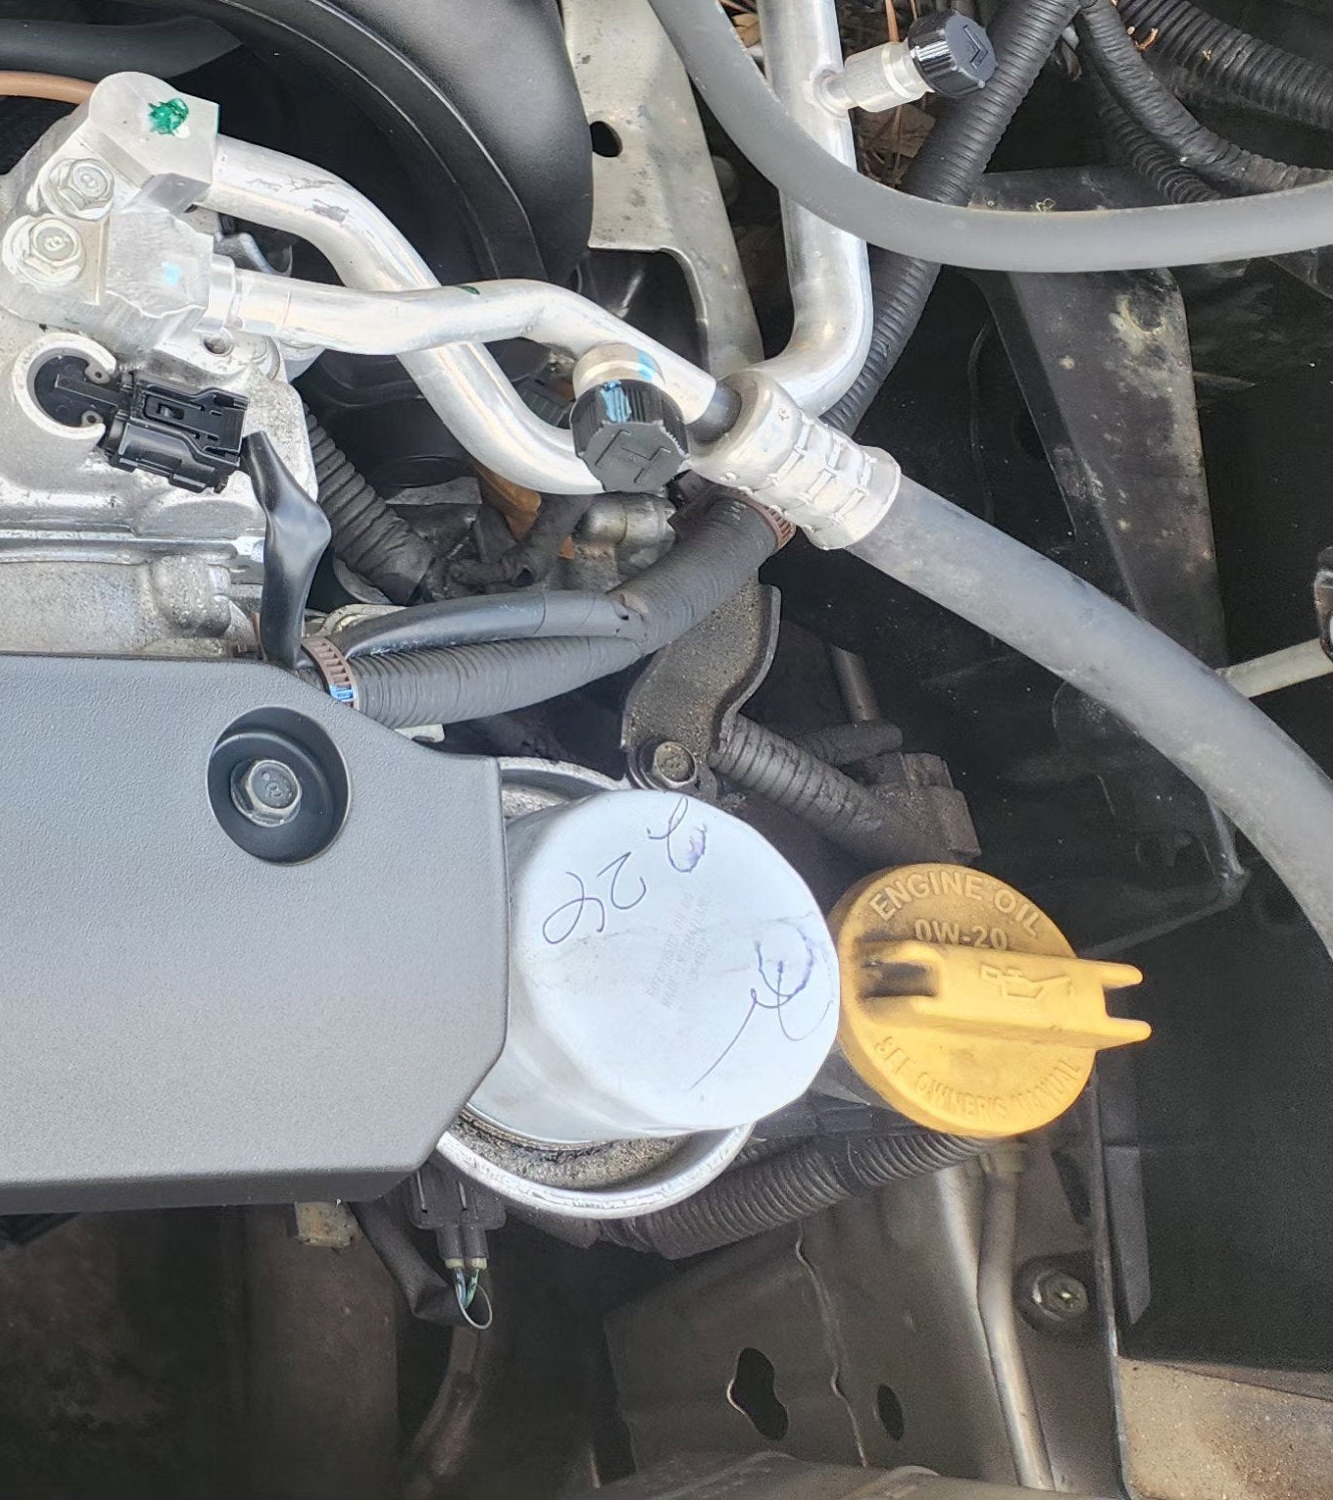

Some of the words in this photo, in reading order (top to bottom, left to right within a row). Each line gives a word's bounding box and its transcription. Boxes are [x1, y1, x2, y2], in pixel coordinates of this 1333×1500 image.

[869, 871, 984, 921] ENGINE
[993, 888, 1042, 938] OIL
[914, 918, 1009, 951] 0W-20
[1014, 1059, 1083, 1112] MANUAL
